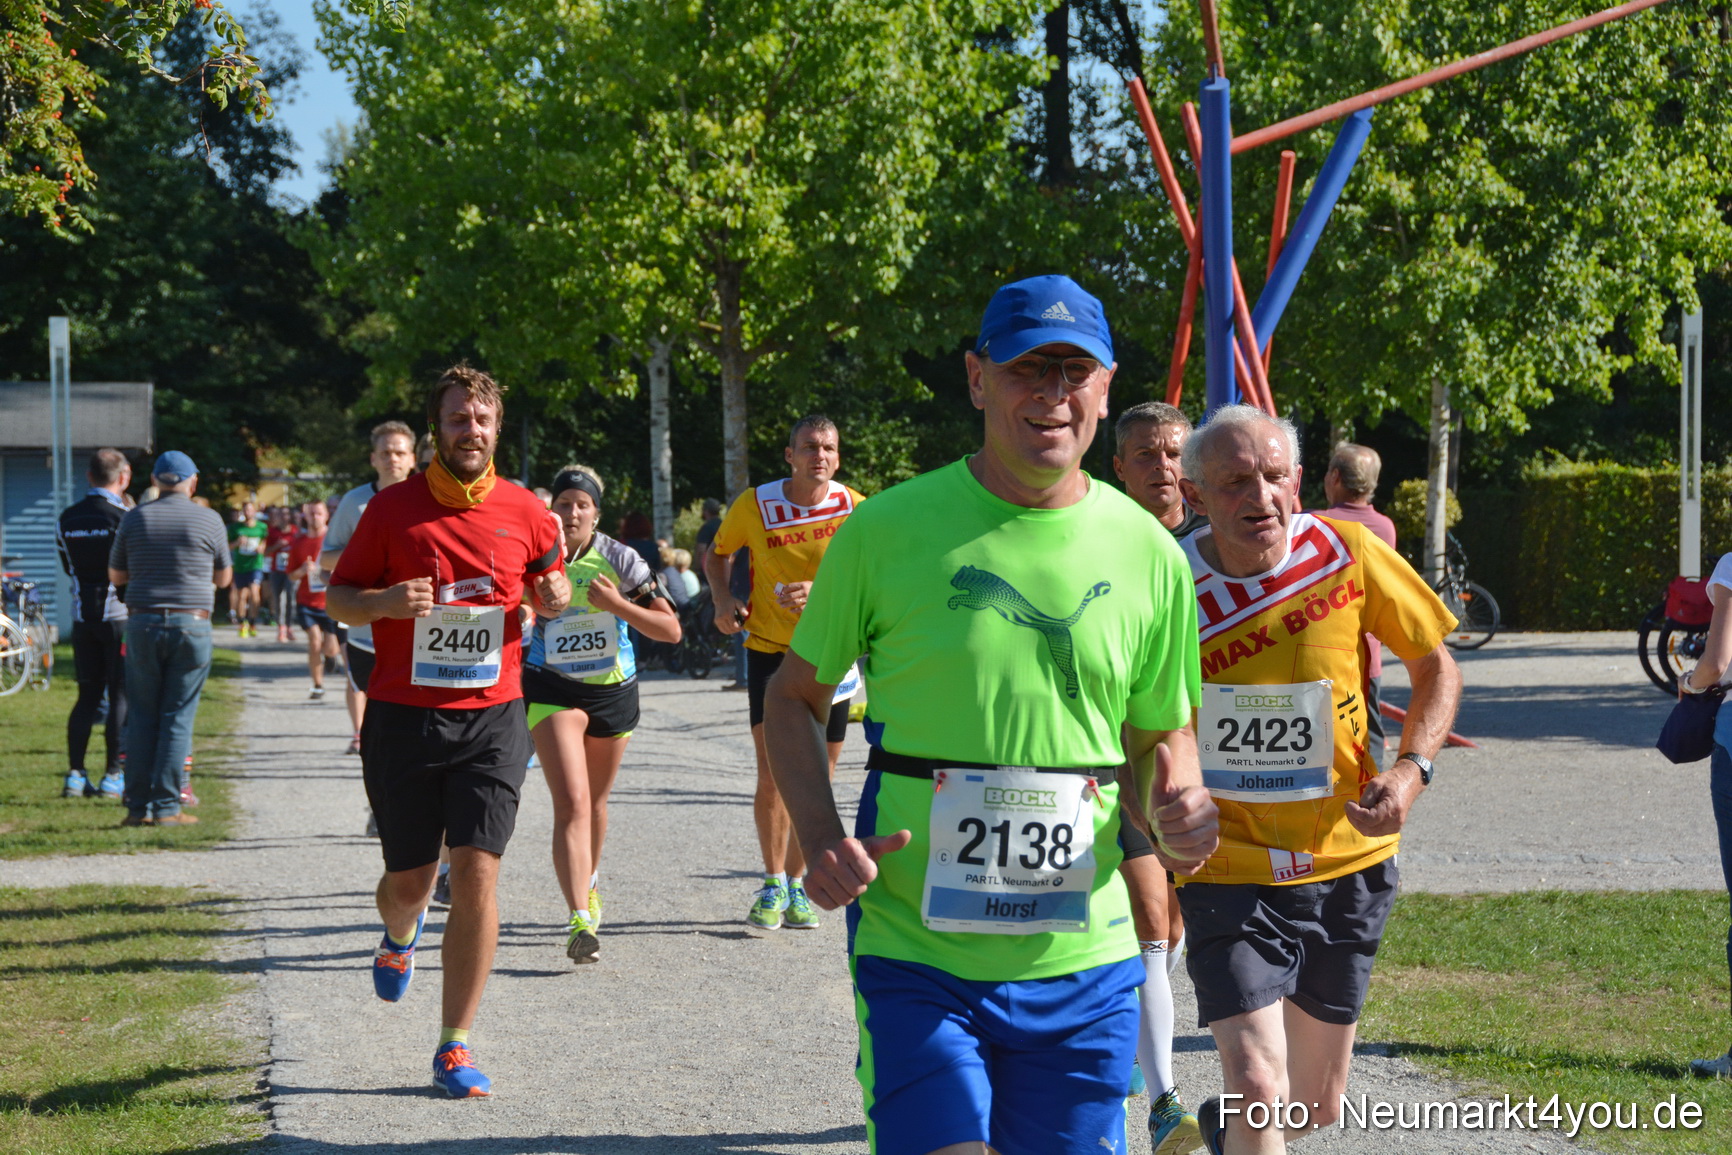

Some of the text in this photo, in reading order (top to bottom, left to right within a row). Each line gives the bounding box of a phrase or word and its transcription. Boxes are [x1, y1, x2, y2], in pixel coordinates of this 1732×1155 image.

[1041, 313, 1075, 322] adidas
[766, 531, 808, 549] MAX
[453, 583, 477, 596] DEHN
[442, 612, 480, 621] BOCK
[1201, 579, 1364, 679] MAX BÖGL
[428, 627, 490, 653] 2440
[556, 631, 606, 653] 2235
[438, 666, 478, 678] Markus
[571, 663, 596, 672] Laura
[1235, 695, 1294, 707] BOCK
[1217, 717, 1313, 752] 2423
[1226, 757, 1294, 766] PARTL Neumarkt
[1236, 774, 1294, 789] Johann
[984, 787, 1057, 808] BOCK
[957, 817, 1073, 871] 2138
[941, 853, 947, 862] C
[965, 874, 1049, 887] PARTL Neumarkt
[984, 896, 1038, 918] Horst
